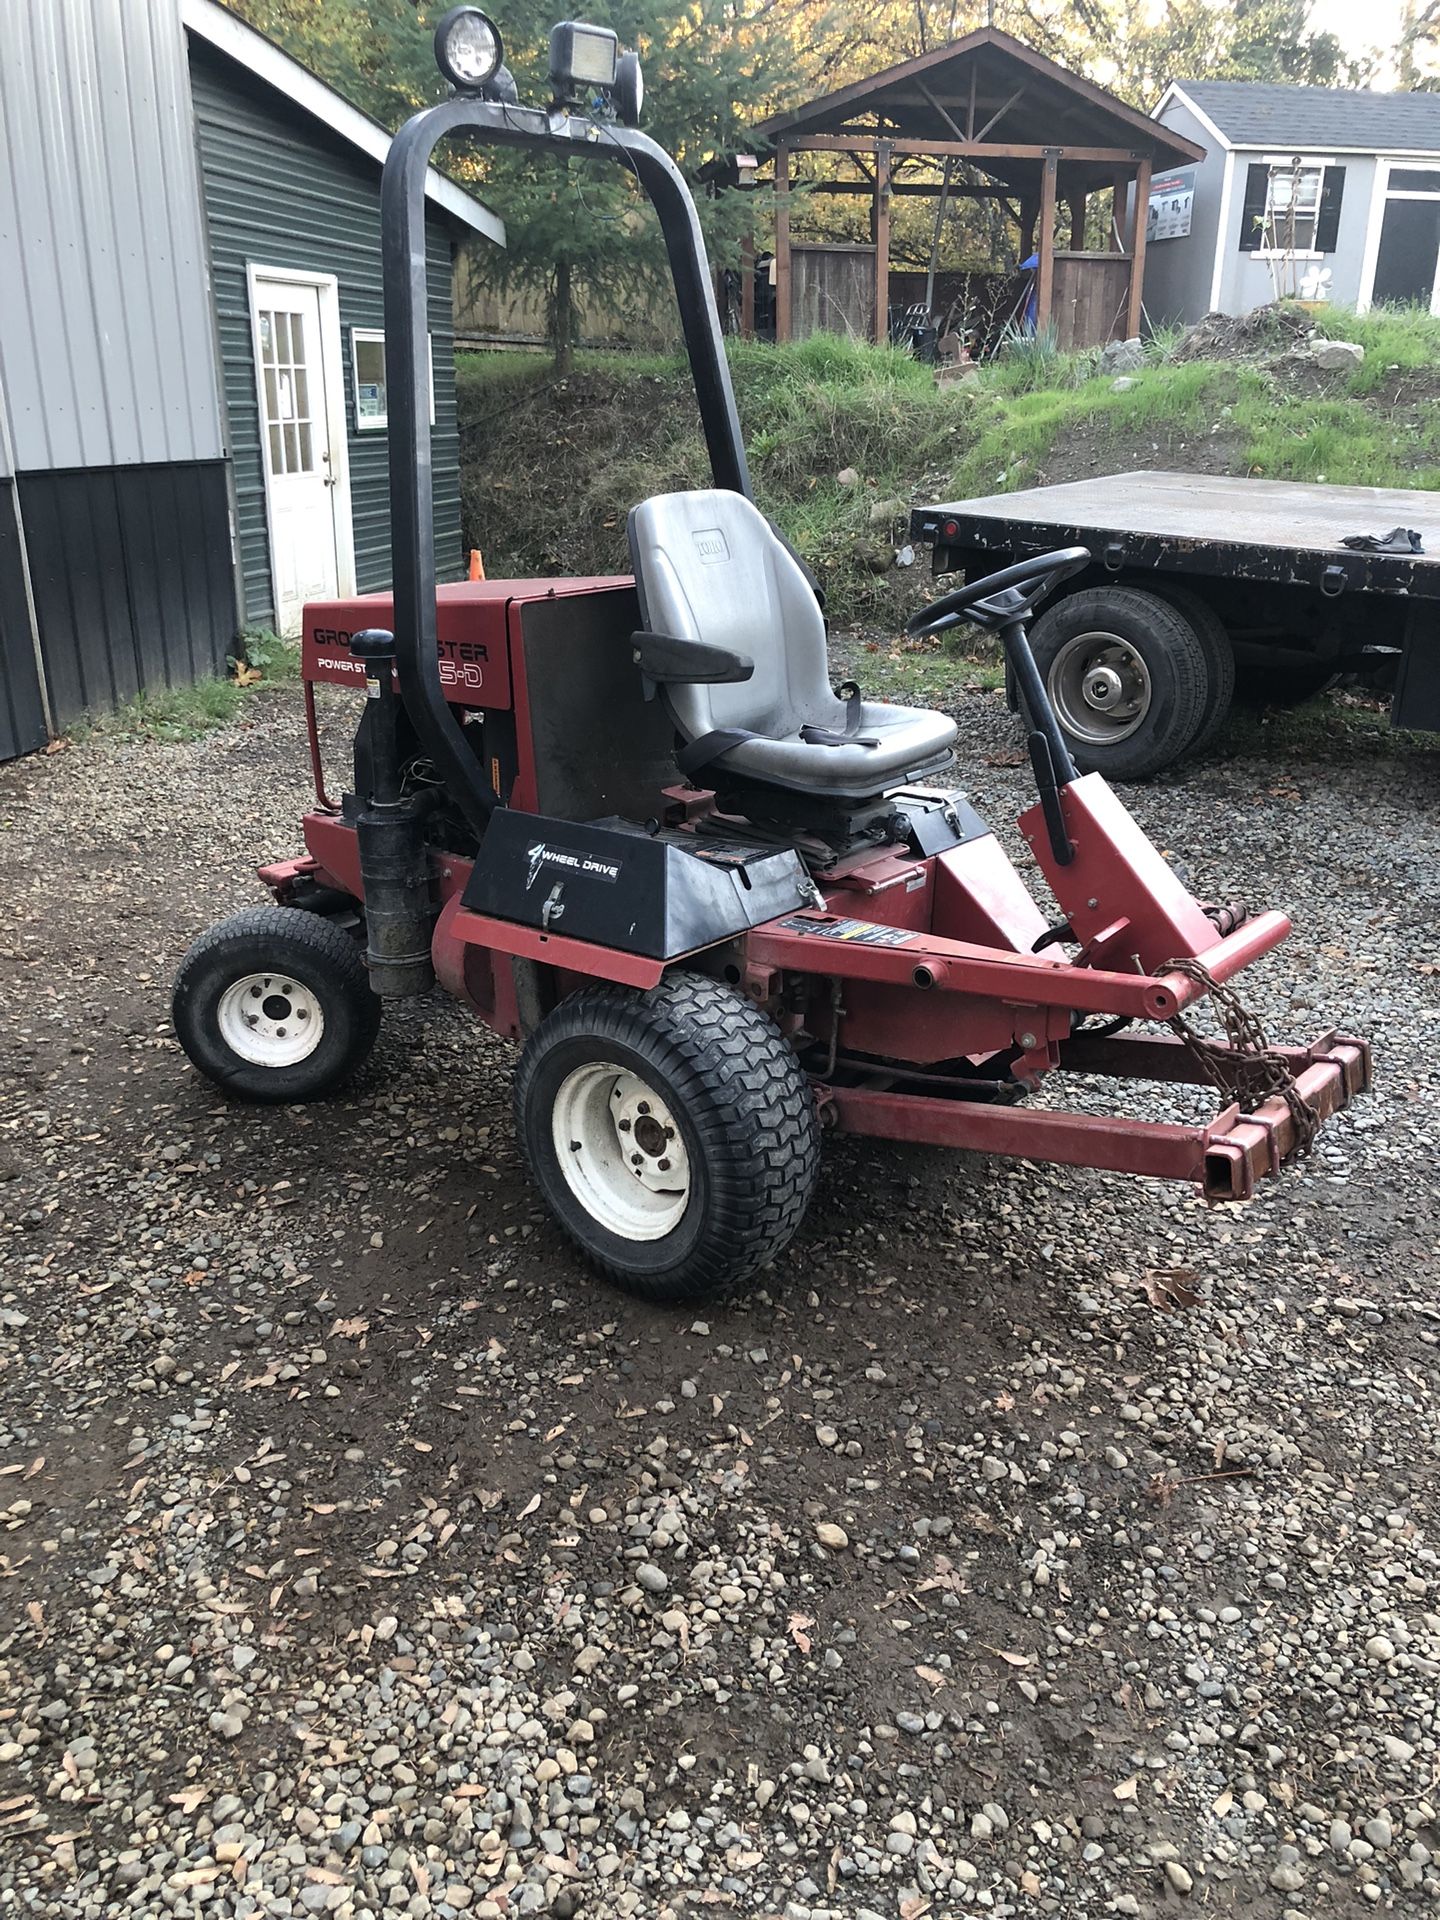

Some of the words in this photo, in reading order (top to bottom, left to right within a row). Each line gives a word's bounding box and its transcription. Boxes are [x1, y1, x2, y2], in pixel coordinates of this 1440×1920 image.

[317, 657, 354, 672] POWER
[541, 850, 580, 868] WHEEL
[582, 860, 619, 878] DRIVE
